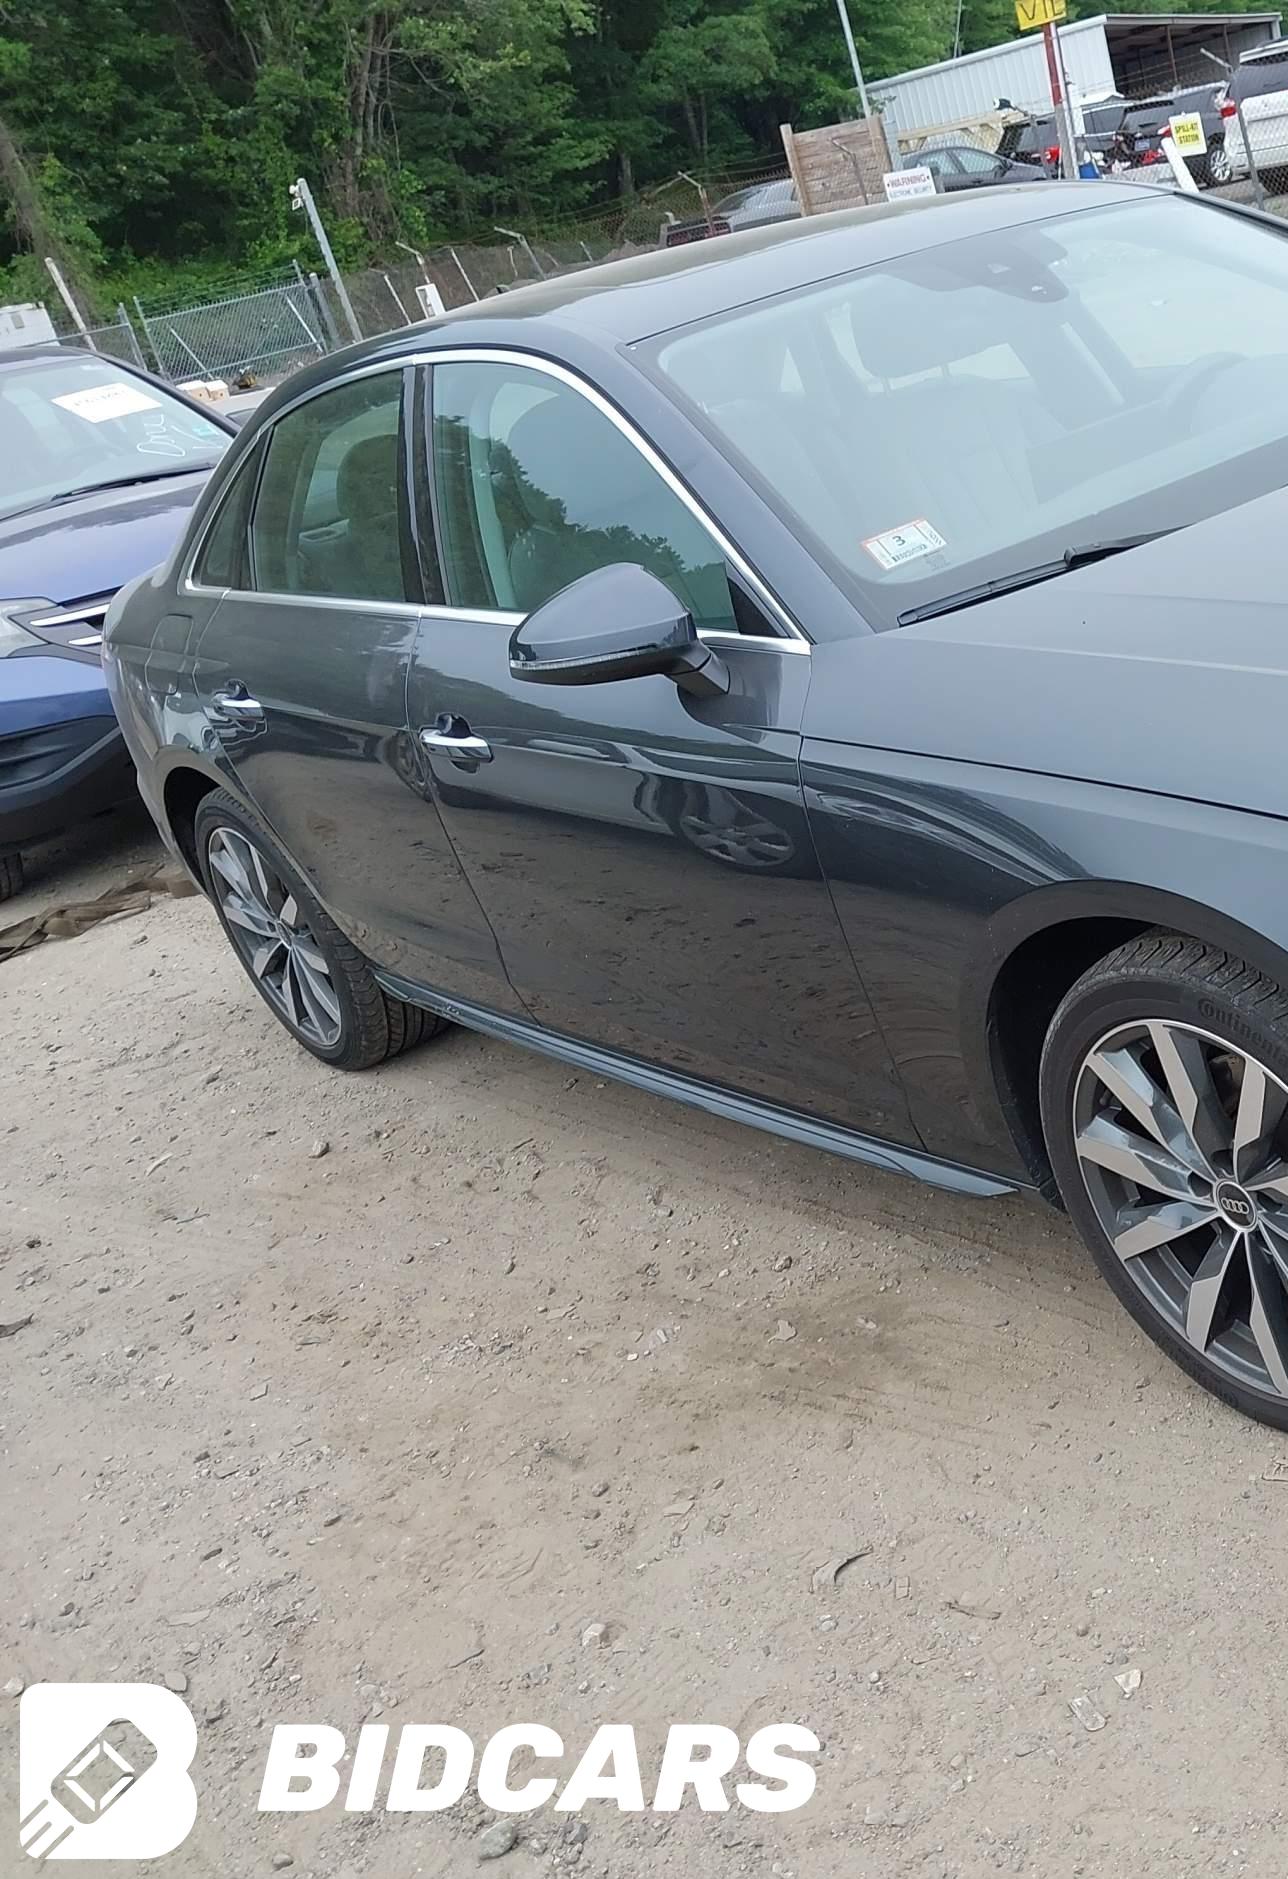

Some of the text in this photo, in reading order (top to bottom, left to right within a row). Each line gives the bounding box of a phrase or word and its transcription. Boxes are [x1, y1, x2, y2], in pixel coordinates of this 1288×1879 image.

[1178, 134, 1200, 145] STATION
[889, 173, 928, 188] WARNING
[892, 535, 906, 547] 3
